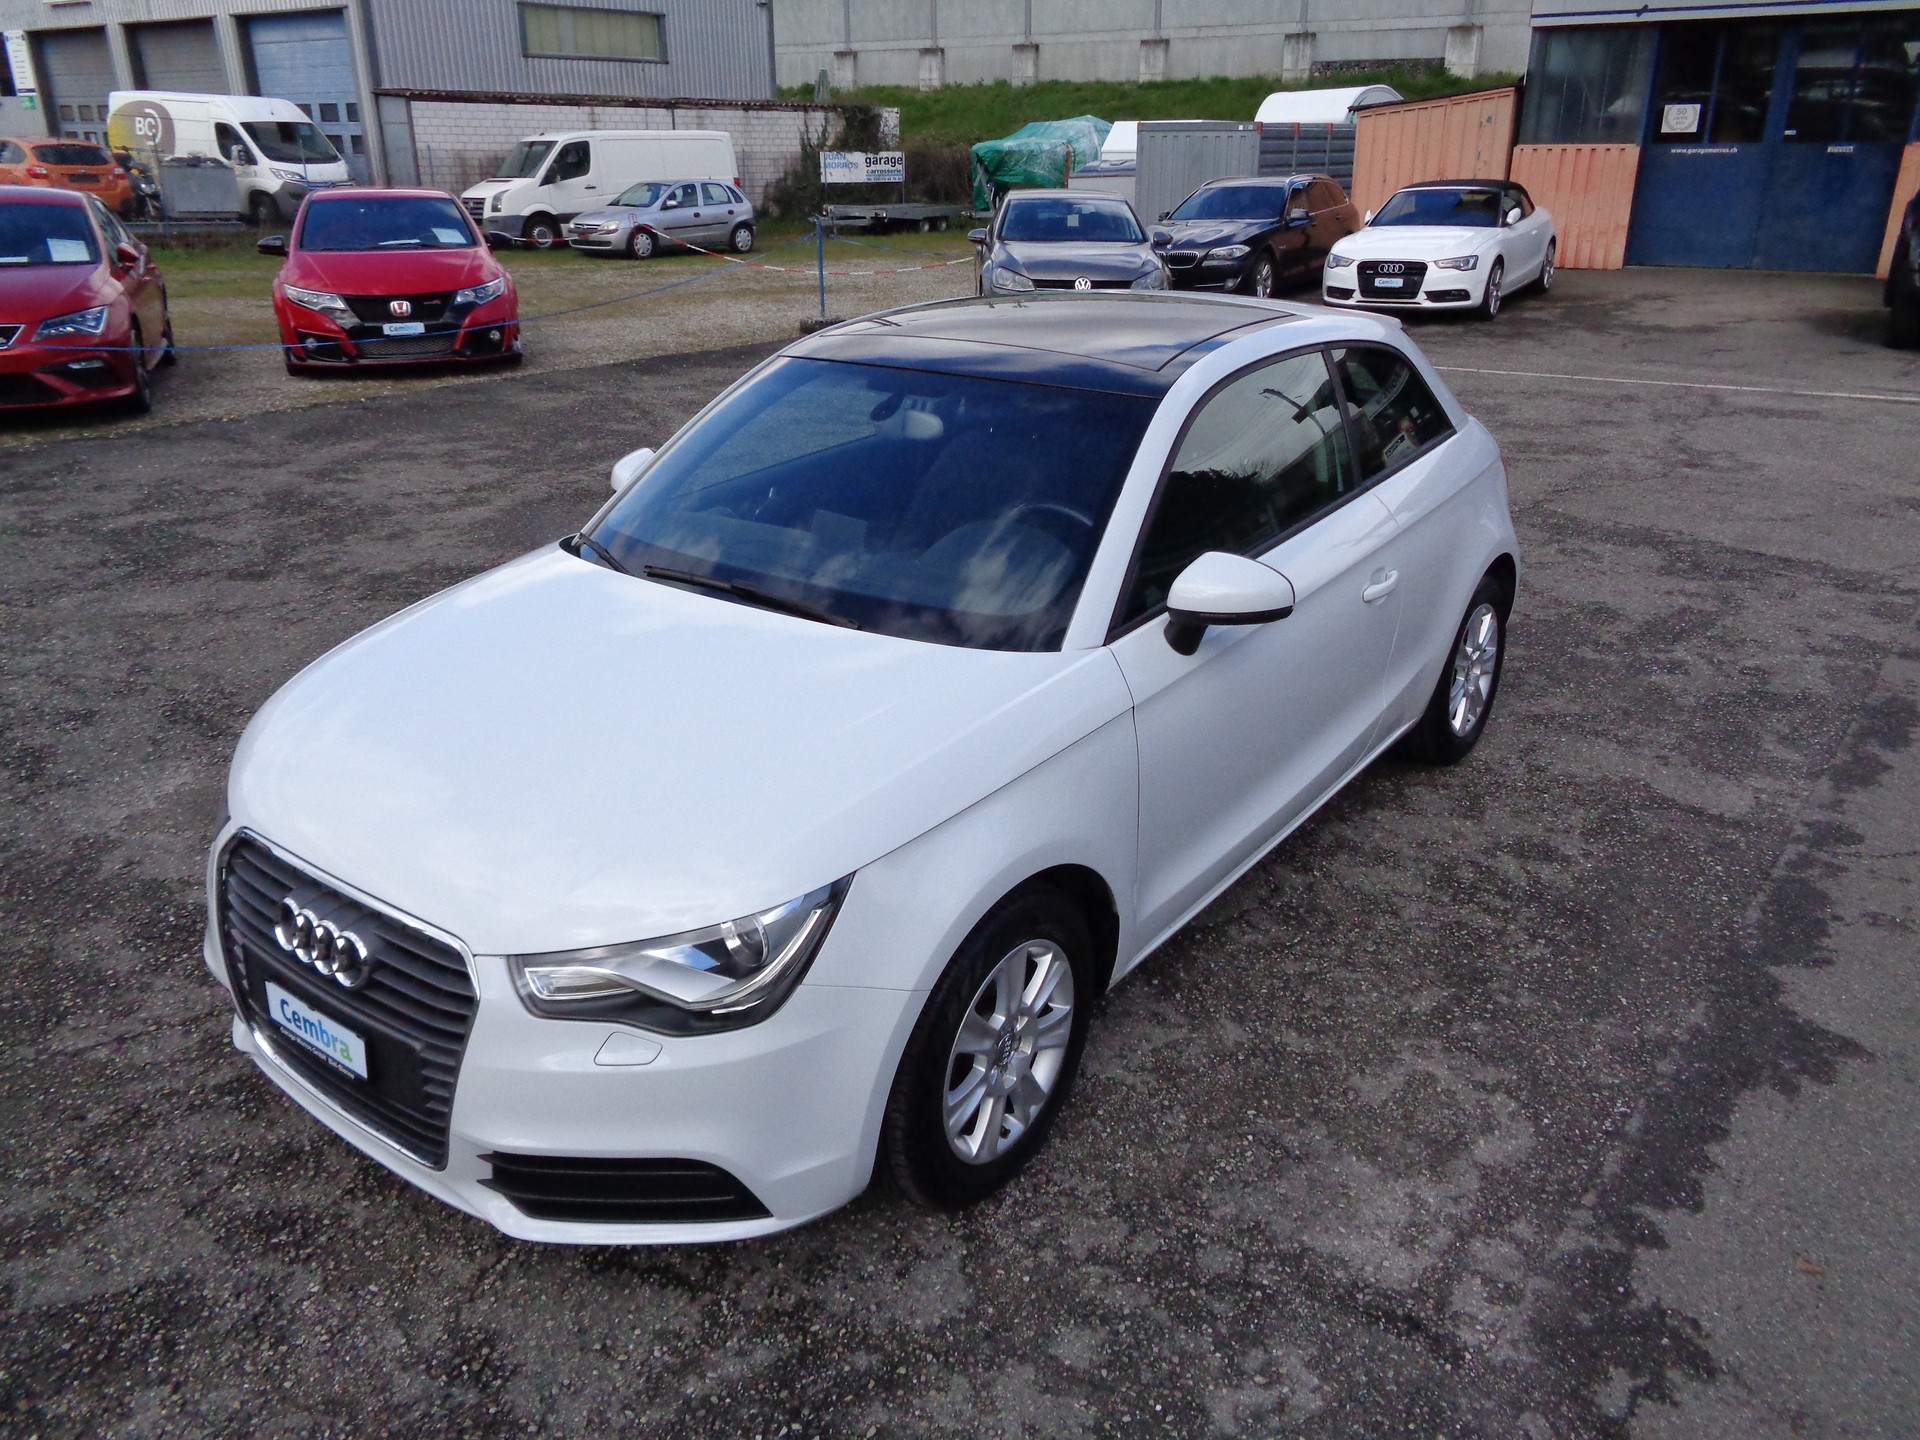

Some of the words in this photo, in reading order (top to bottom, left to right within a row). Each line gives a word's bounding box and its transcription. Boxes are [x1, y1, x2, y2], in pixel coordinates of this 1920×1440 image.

[1676, 107, 1688, 115] 50
[135, 116, 156, 136] BC
[865, 156, 903, 168] garage
[280, 999, 352, 1062] Cembra
